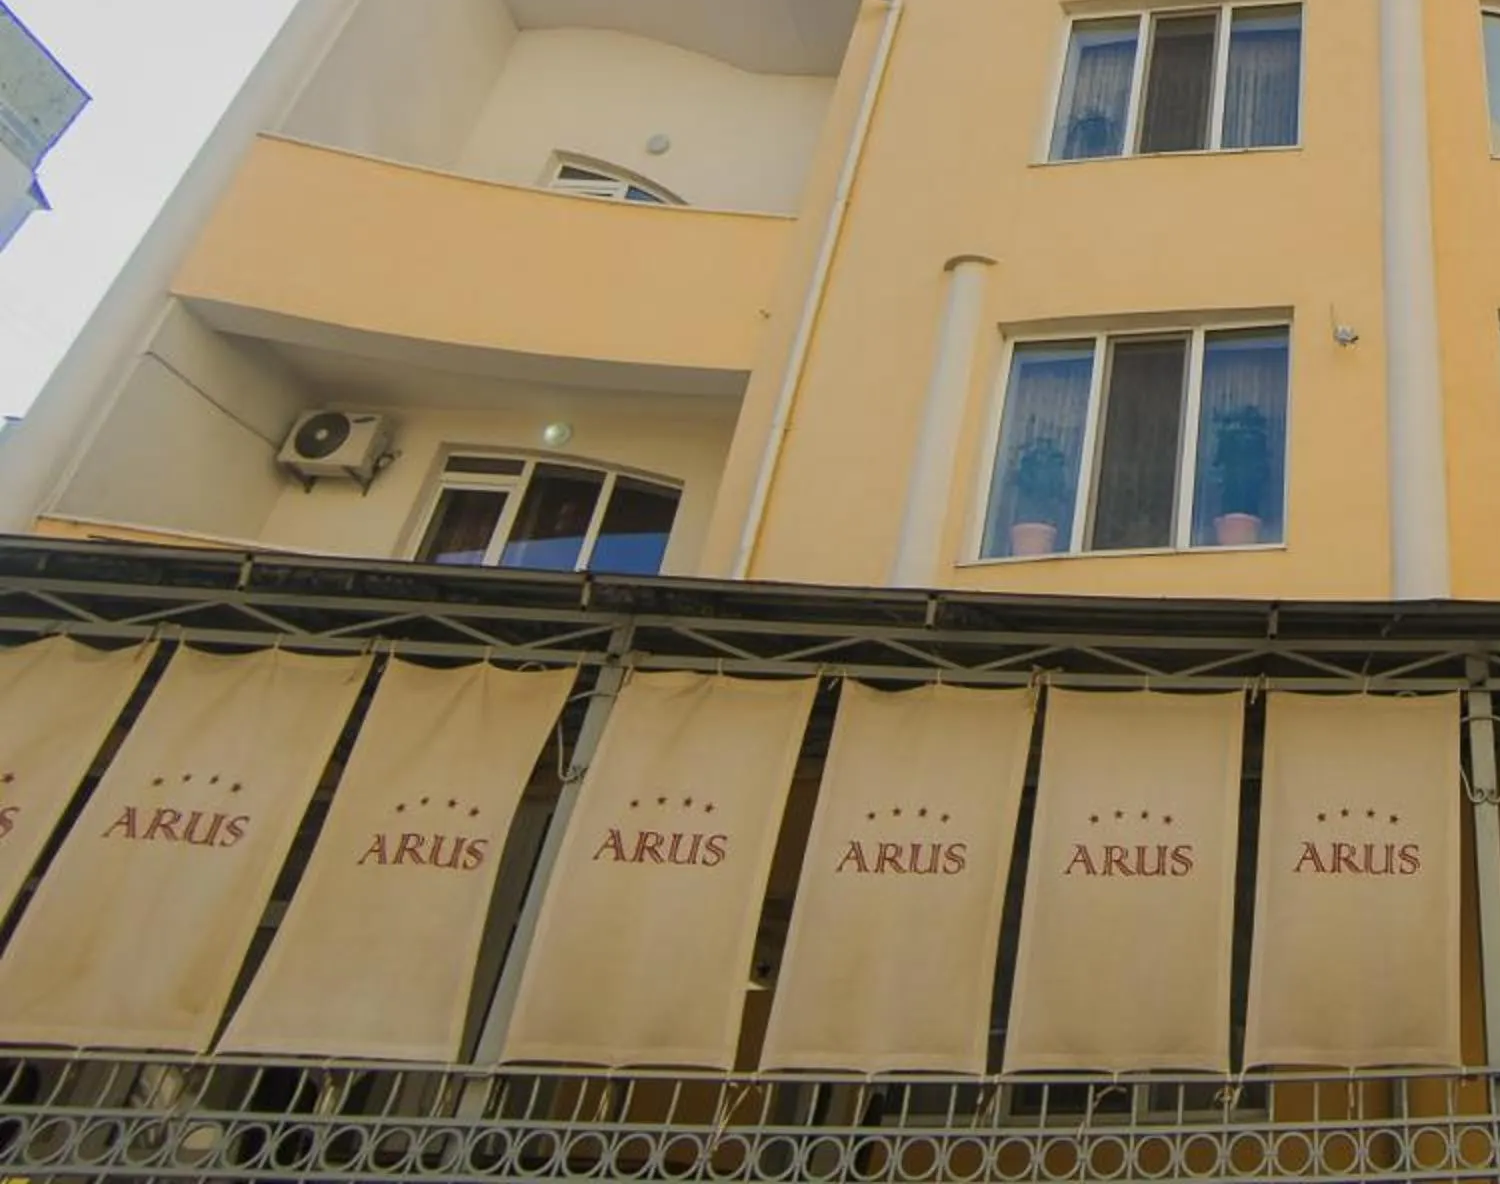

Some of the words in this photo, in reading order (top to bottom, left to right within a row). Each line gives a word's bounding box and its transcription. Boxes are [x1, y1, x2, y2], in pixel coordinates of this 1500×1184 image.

[102, 806, 249, 846] ARUS
[358, 832, 488, 869] ARUS
[594, 828, 727, 866] ARUS
[836, 840, 967, 875] ARUS
[1065, 843, 1193, 877] ARUS
[1293, 842, 1421, 875] ARUS
